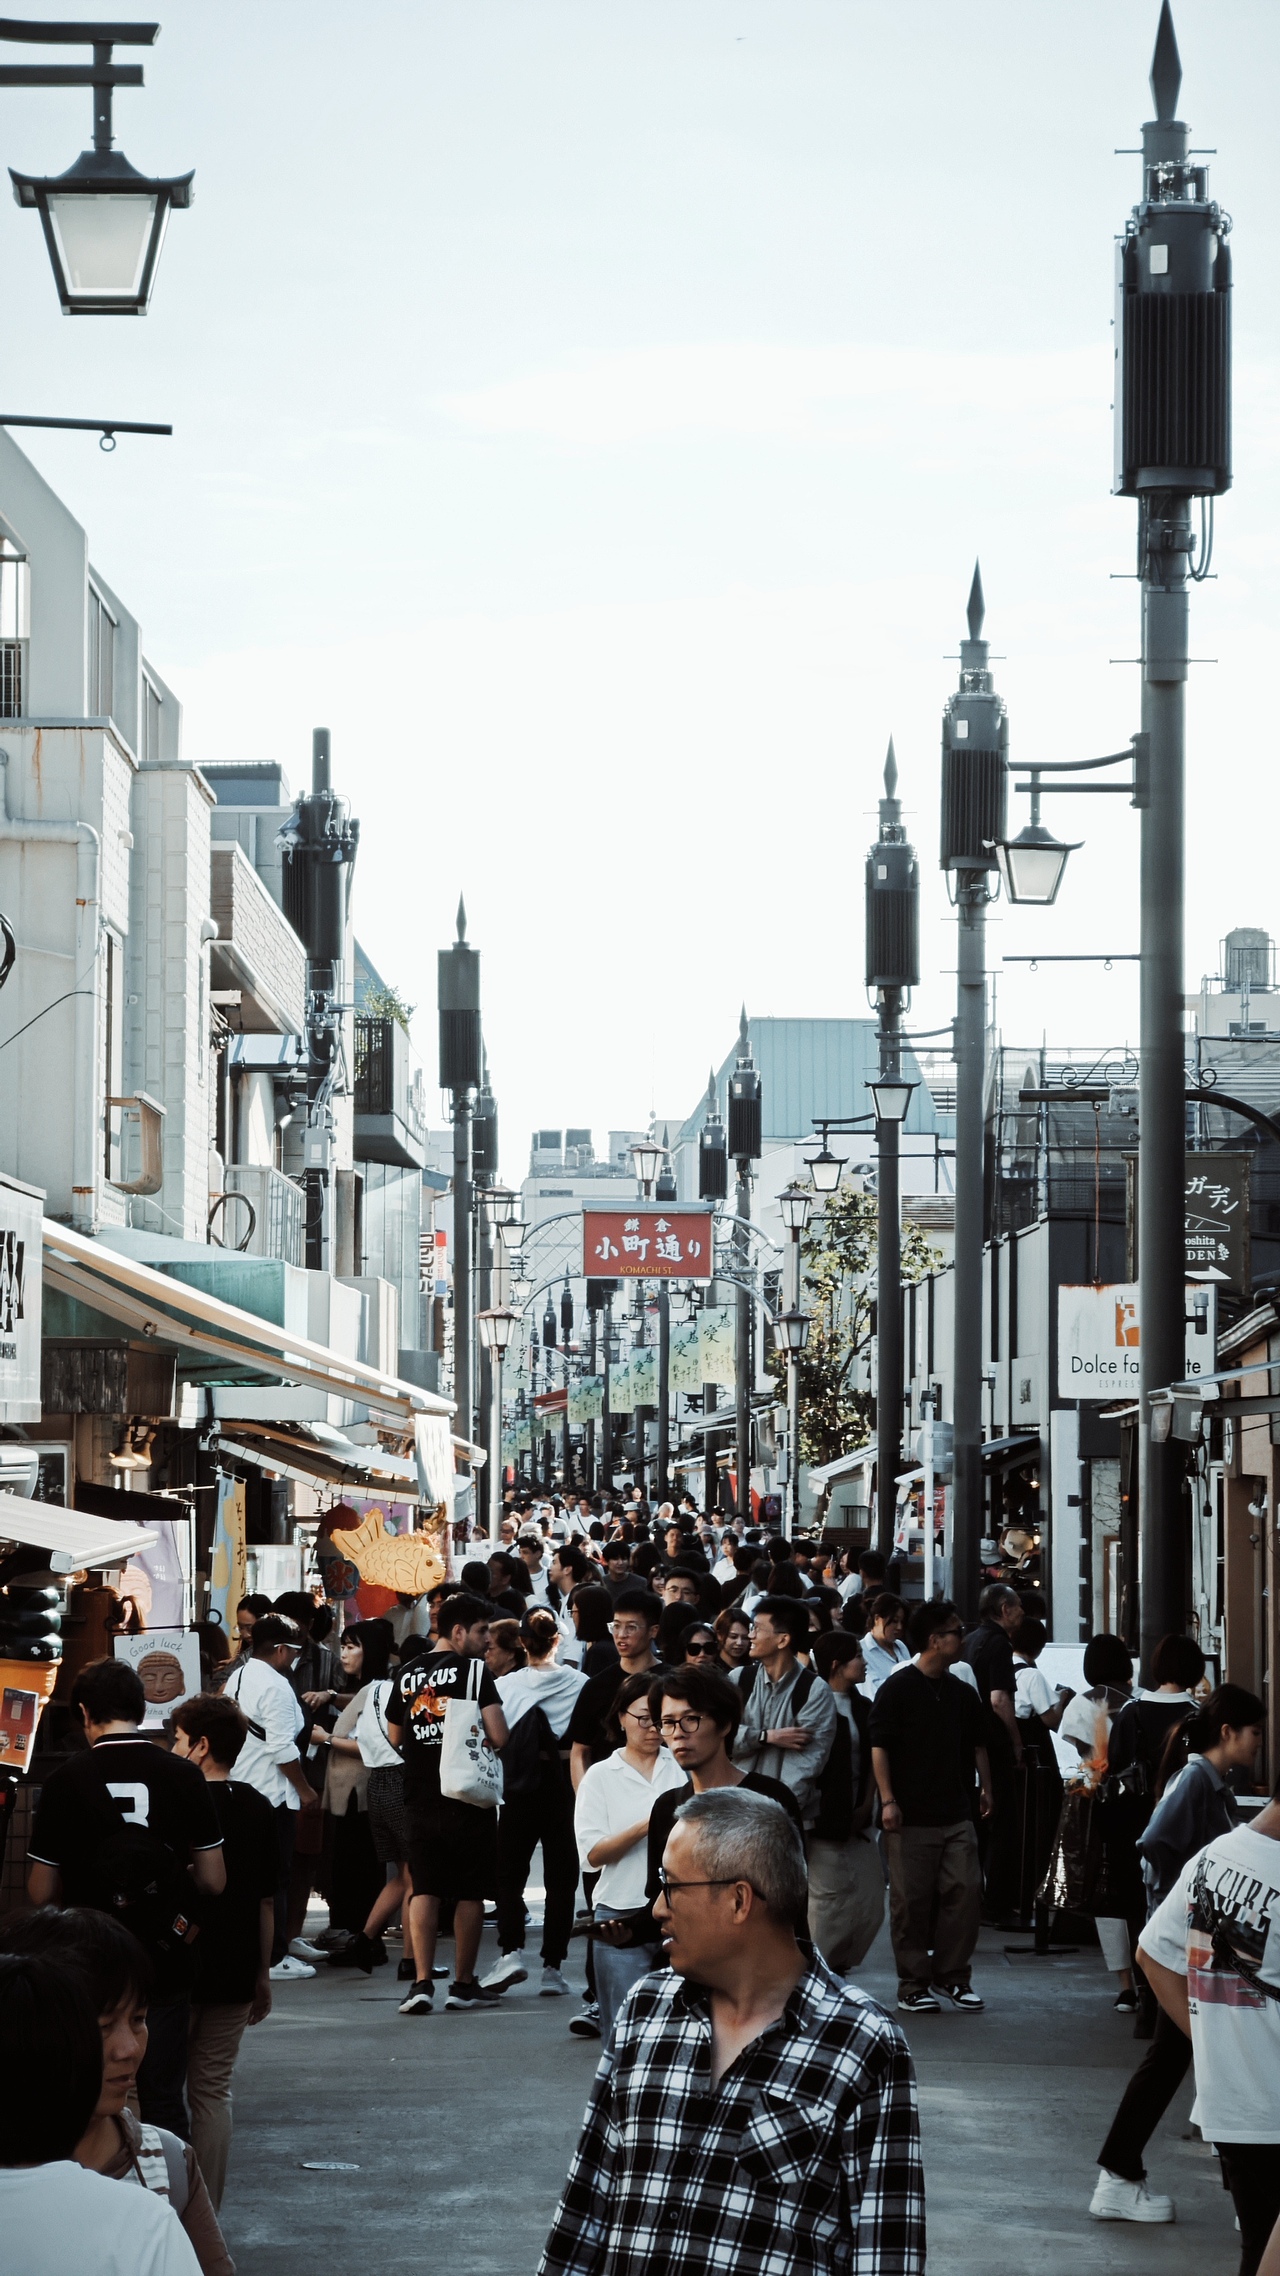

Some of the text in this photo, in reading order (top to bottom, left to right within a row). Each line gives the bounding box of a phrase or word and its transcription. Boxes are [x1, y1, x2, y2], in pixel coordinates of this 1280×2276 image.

[1185, 1175, 1239, 1214] ガーデン
[623, 1217, 672, 1232] 鎌倉
[595, 1234, 701, 1262] 小町通り
[1185, 1235, 1216, 1246] oshita
[1186, 1250, 1216, 1261] DEN
[620, 1265, 674, 1275] KOMACHI ST.
[1071, 1353, 1140, 1374] Dolce fa
[323, 1559, 355, 1594] 氷
[129, 1637, 184, 1658] Good luck
[400, 1667, 458, 1696] CIRCUS
